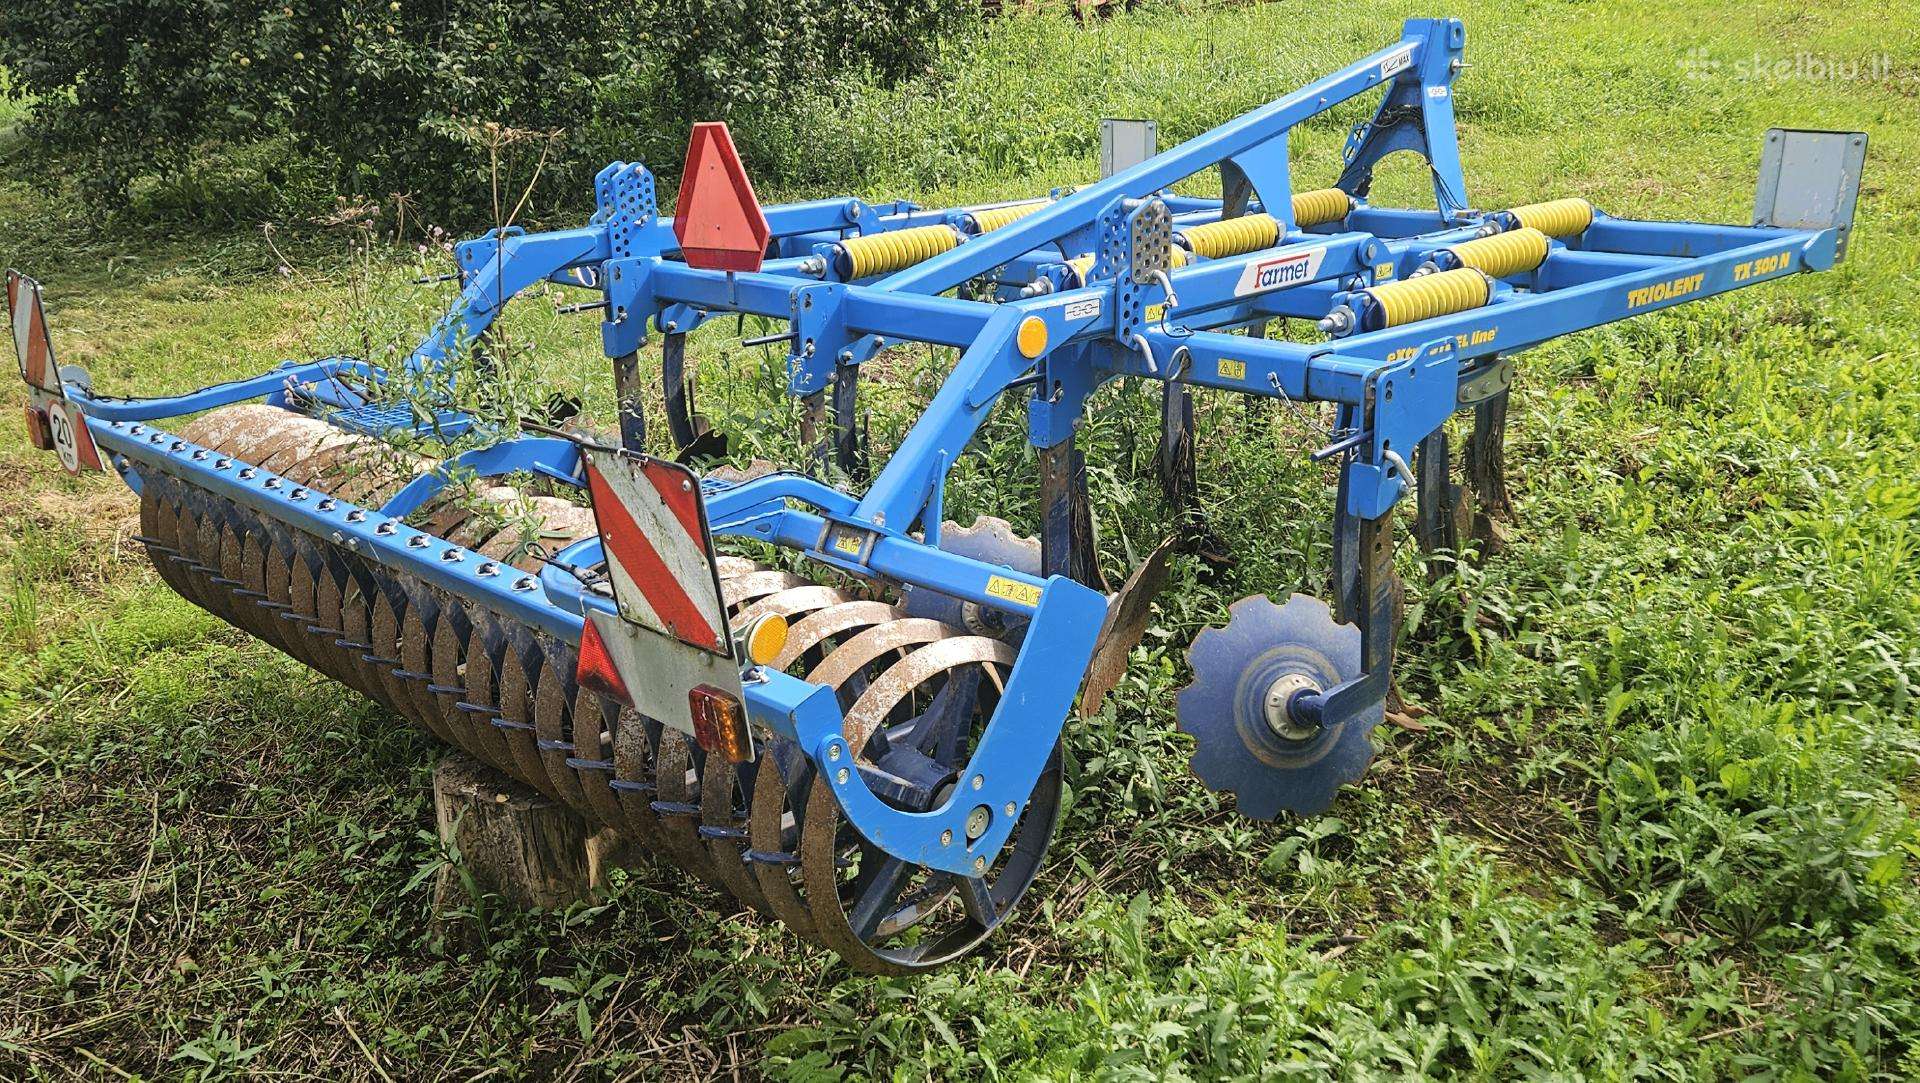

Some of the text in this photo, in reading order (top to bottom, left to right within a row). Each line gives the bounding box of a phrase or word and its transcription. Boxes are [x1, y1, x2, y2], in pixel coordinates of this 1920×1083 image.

[1254, 253, 1310, 288] Farmet
[1733, 251, 1791, 282] TX 300 N
[1628, 273, 1705, 308] TRIOLENT
[53, 414, 72, 448] 20
